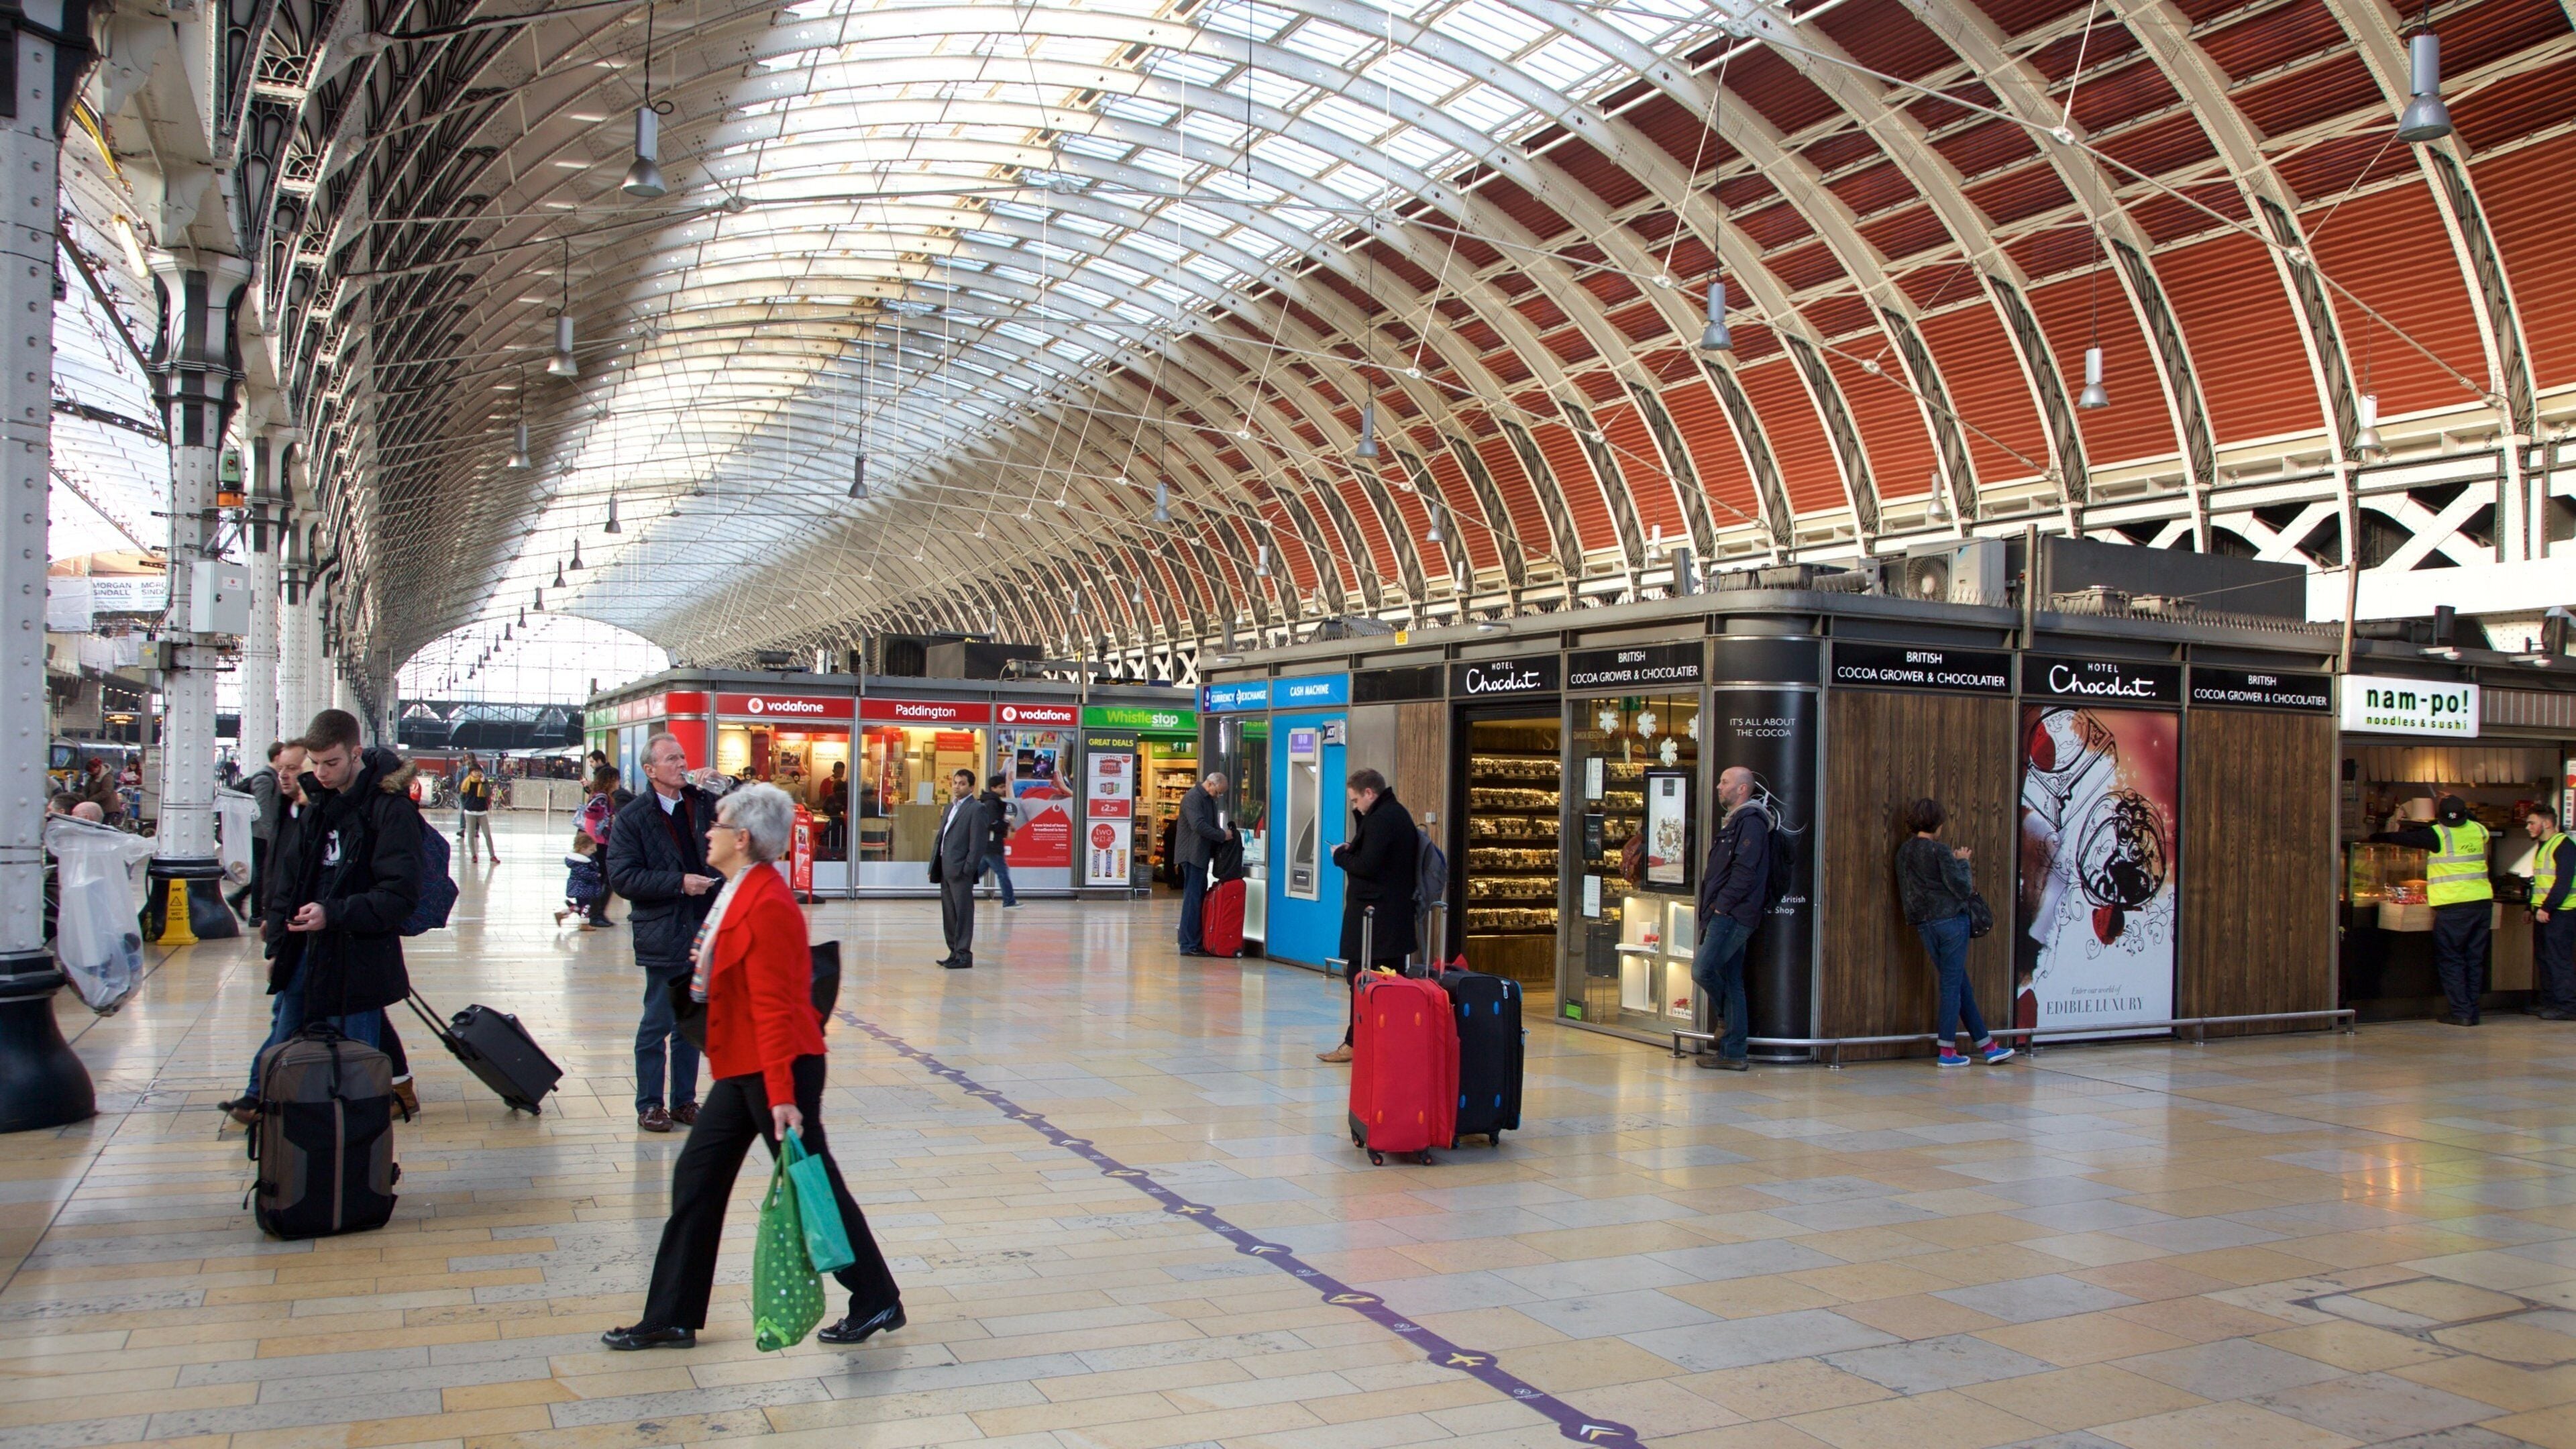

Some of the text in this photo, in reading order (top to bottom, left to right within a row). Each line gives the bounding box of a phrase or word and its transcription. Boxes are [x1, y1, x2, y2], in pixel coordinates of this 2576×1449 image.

[1618, 651, 1646, 663] BRITISH
[1907, 651, 1942, 664] BRITISH
[1491, 661, 1514, 670] HOTEL
[2088, 663, 2119, 674] HOTEL
[1570, 665, 1698, 684] COCOA GROWER & CHOCOLATIER
[1837, 667, 2006, 687] COCOA GROWER & CHOCOLATIER
[2248, 675, 2277, 686] BRITISH
[1212, 690, 1267, 703] CURRENCY EXCHANGE
[1290, 684, 1330, 697] CASH MACHINE
[2194, 685, 2327, 706] COCOA GROWER & CHOCOLATIER
[767, 700, 824, 712] vodafone
[2367, 688, 2468, 716] nam-po!
[896, 704, 956, 720] Paddington
[1020, 709, 1071, 720] vodafone
[1106, 710, 1179, 728] Whistlestop
[1729, 718, 1743, 726] IT'S
[1764, 718, 1796, 726] ABOUT
[2367, 716, 2467, 730] noodles & sushi
[1756, 729, 1791, 737] COCOA
[1089, 738, 1110, 746] GREAT
[1096, 828, 1112, 836] two
[1775, 906, 1794, 916] Shop
[2098, 985, 2114, 994] world
[2114, 985, 2122, 994] of
[2047, 997, 2144, 1014] EDIBLE LUXURY
